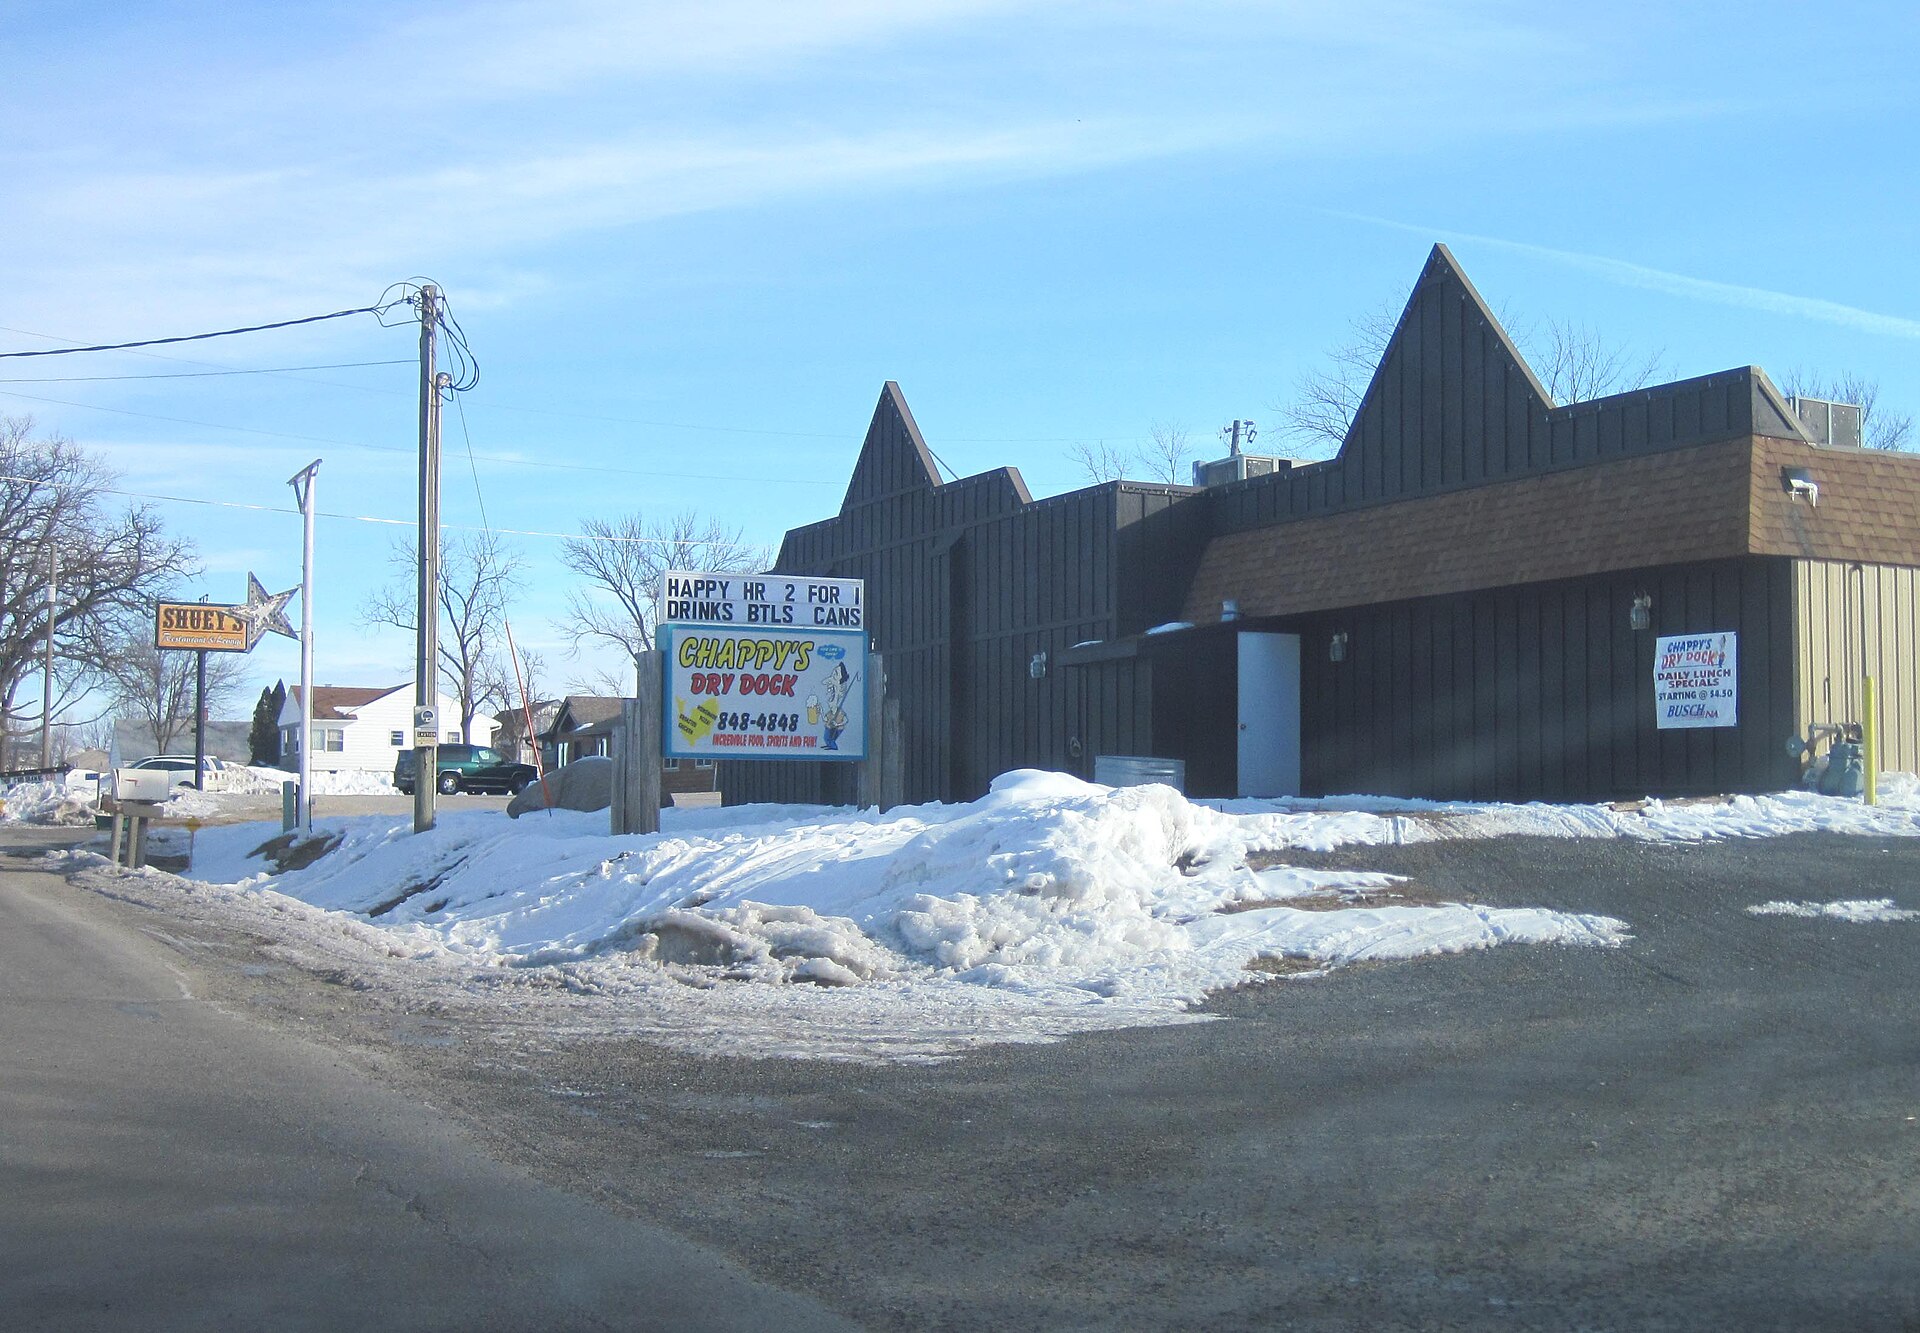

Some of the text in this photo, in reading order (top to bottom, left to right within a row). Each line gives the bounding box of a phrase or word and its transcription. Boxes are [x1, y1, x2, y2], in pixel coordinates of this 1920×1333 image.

[668, 578, 730, 598] HAPPY
[743, 582, 765, 601] HR
[785, 584, 795, 602] 2
[808, 585, 840, 604] FOR
[163, 607, 243, 631] SHUEYS
[667, 601, 860, 626] DRINKS BTLS CANS
[679, 637, 814, 671] CHAPPY'S
[1667, 639, 1712, 653] CHAPPY'S
[1661, 650, 1715, 669] DRY DOCK
[1658, 669, 1731, 681] DAILY LUNCH
[1668, 678, 1719, 689] SPECIALS
[690, 673, 798, 697] DRY DOCK
[1658, 691, 1697, 701] STARTING
[1698, 690, 1708, 700] @
[1667, 704, 1706, 718] BUSCH
[717, 712, 799, 732] 848-4848
[712, 734, 747, 747] INCREDIBLE
[766, 734, 788, 747] SPIRITS
[789, 735, 802, 747] AND
